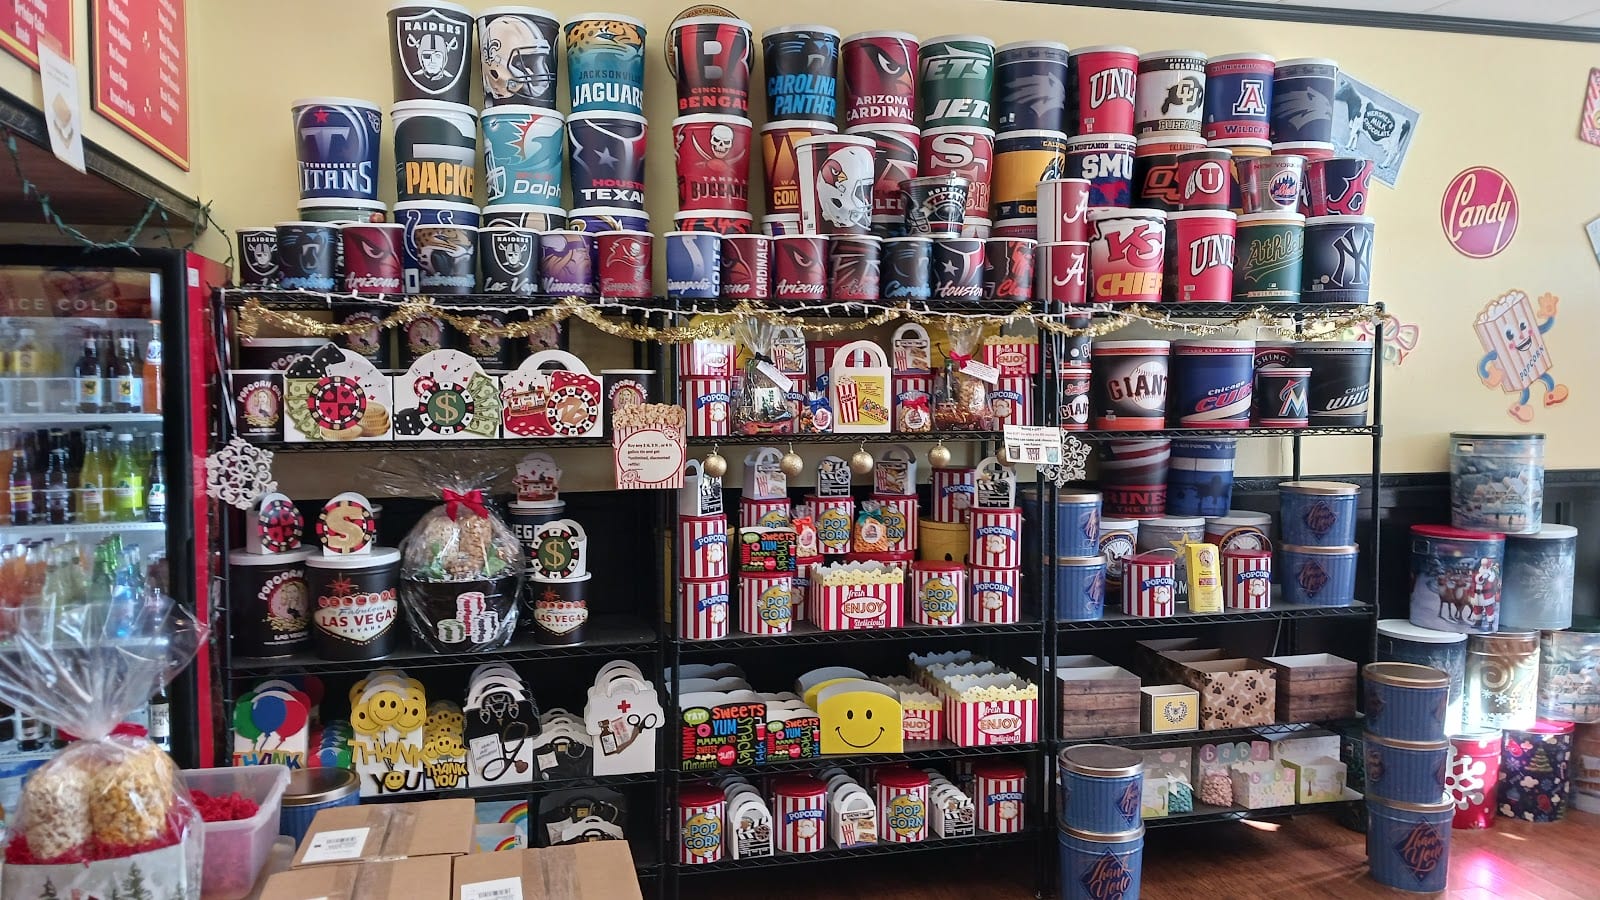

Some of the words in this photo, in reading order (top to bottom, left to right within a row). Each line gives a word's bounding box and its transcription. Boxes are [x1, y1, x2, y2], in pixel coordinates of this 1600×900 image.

[404, 22, 461, 35] RAIDERS
[768, 73, 836, 97] CAROLINA
[856, 95, 909, 106] ARIZONA
[1370, 118, 1388, 130] MILK
[1082, 153, 1134, 180] SMU
[1199, 167, 1220, 191] U
[1450, 173, 1511, 254] Candy
[497, 235, 530, 244] RAIDERS
[711, 239, 721, 297] COLTS
[756, 239, 768, 298] CARDINALS
[345, 271, 400, 289] Arizona
[776, 279, 825, 296] Arizona
[934, 280, 983, 298] Houston
[8, 298, 45, 311] ICE
[57, 299, 119, 312] COLD
[998, 355, 1026, 365] ENJOY
[1519, 345, 1545, 382] POPCORN
[237, 380, 272, 403] POPCORN
[608, 380, 636, 400] POPCORN
[1208, 381, 1245, 396] chicago
[823, 518, 847, 530] POP
[818, 530, 850, 540] CORN
[979, 527, 1014, 537] POPCORN
[761, 541, 777, 551] YUM
[975, 583, 1010, 592] POPCORN
[927, 589, 953, 601] POP
[767, 596, 790, 608] POP
[843, 601, 884, 614] ENJOY
[921, 601, 957, 612] CORN
[322, 615, 348, 628] LAS
[354, 606, 398, 626] VEGAS
[338, 605, 387, 616] Fabulous
[760, 609, 792, 620] CORN
[536, 613, 552, 623] LAS
[554, 613, 587, 624] VEGAS
[712, 719, 737, 736] YUM
[980, 718, 1019, 730] ENJOY
[785, 728, 801, 738] YUM
[232, 751, 305, 770] THANK
[348, 739, 433, 769] THANK
[426, 761, 468, 778] THANK
[432, 773, 459, 788] YOU
[990, 793, 1024, 802] POPCORN
[788, 810, 823, 821] POPCORN
[895, 805, 921, 816] POP
[889, 817, 924, 828] CORN
[691, 823, 718, 836] POP
[685, 836, 720, 849] CORN
